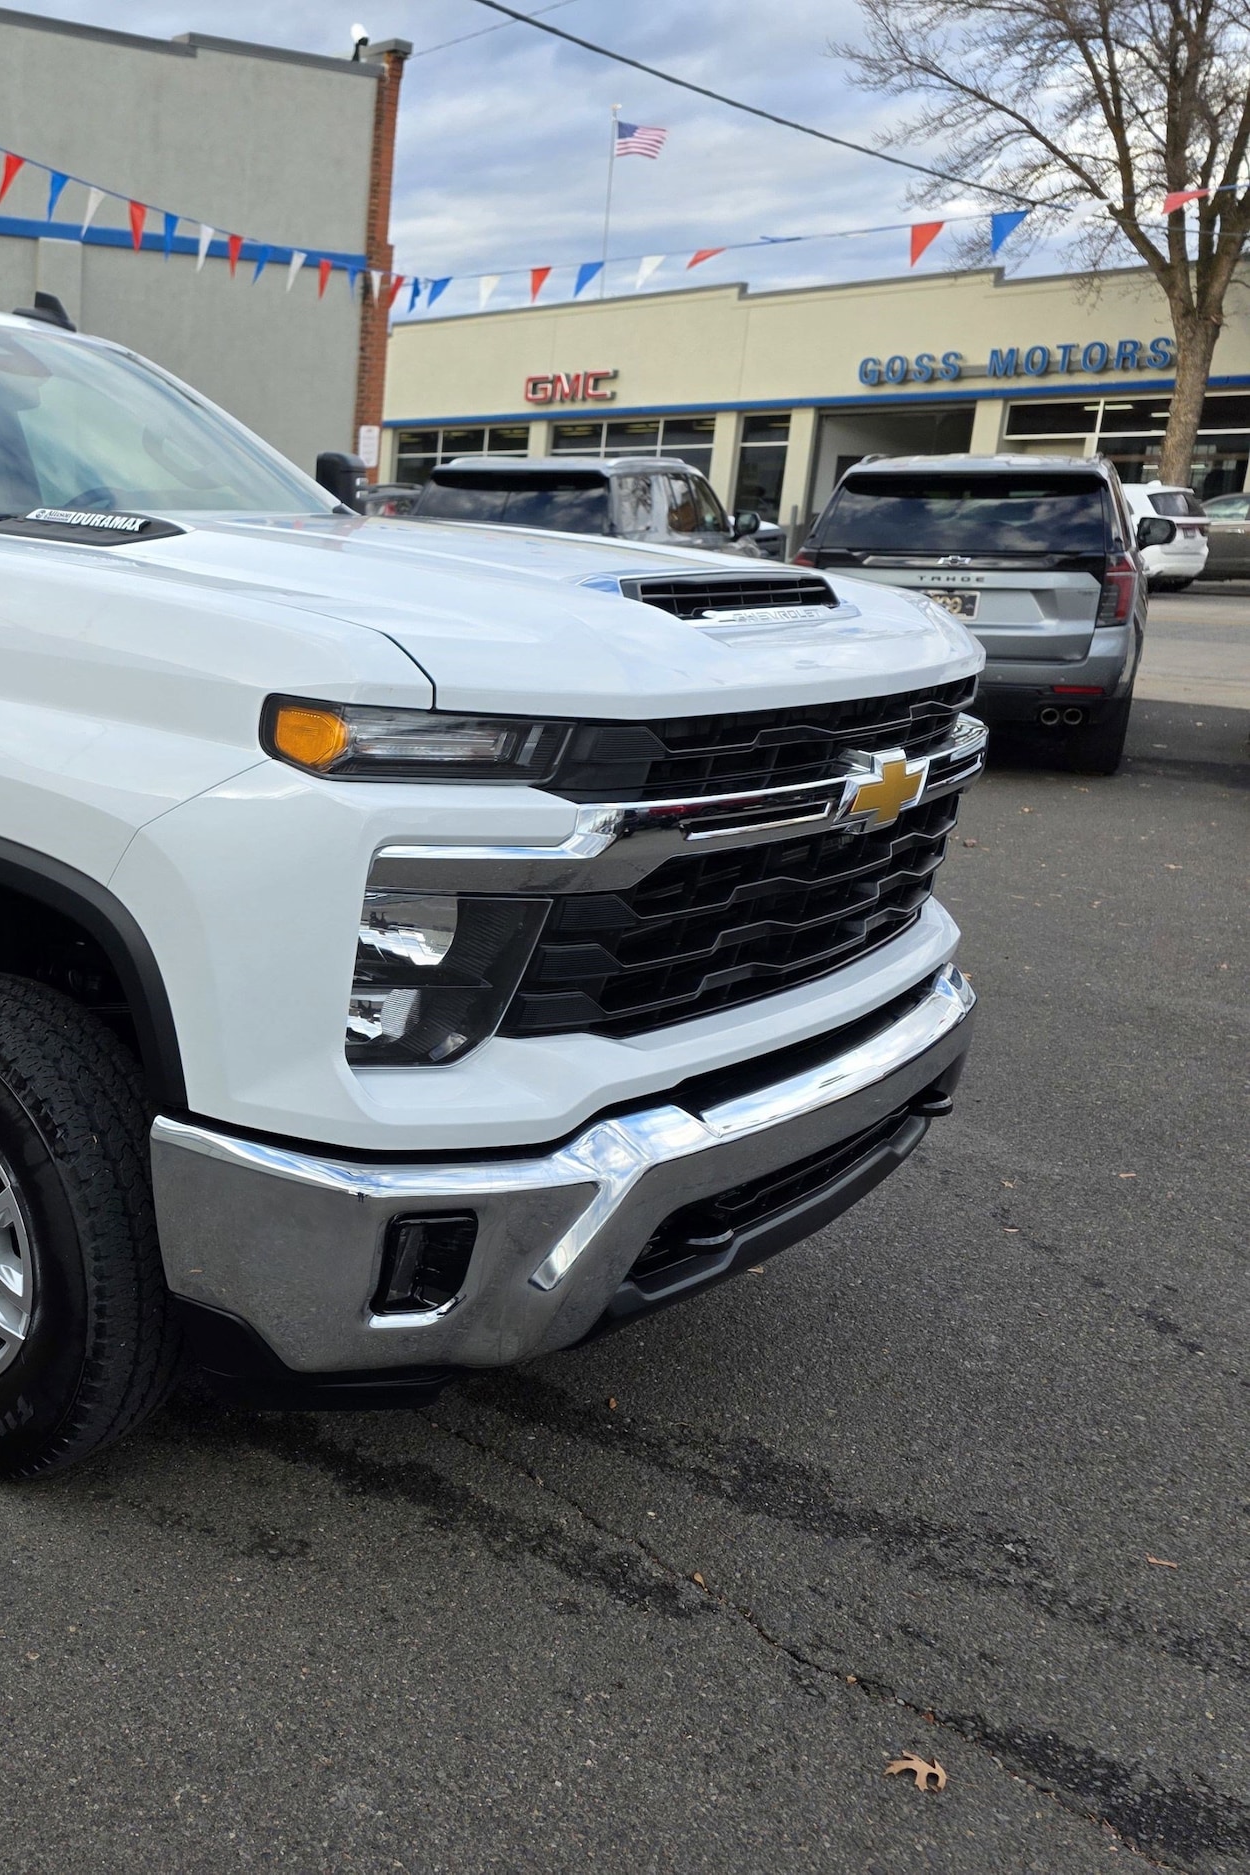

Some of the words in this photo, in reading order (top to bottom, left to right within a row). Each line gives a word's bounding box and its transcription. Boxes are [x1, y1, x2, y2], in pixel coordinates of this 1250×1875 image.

[858, 351, 962, 386] GOSS
[987, 337, 1175, 377] MOTORS
[524, 369, 617, 404] GMC
[70, 511, 147, 532] DURAMAX
[918, 575, 986, 583] TAHOE
